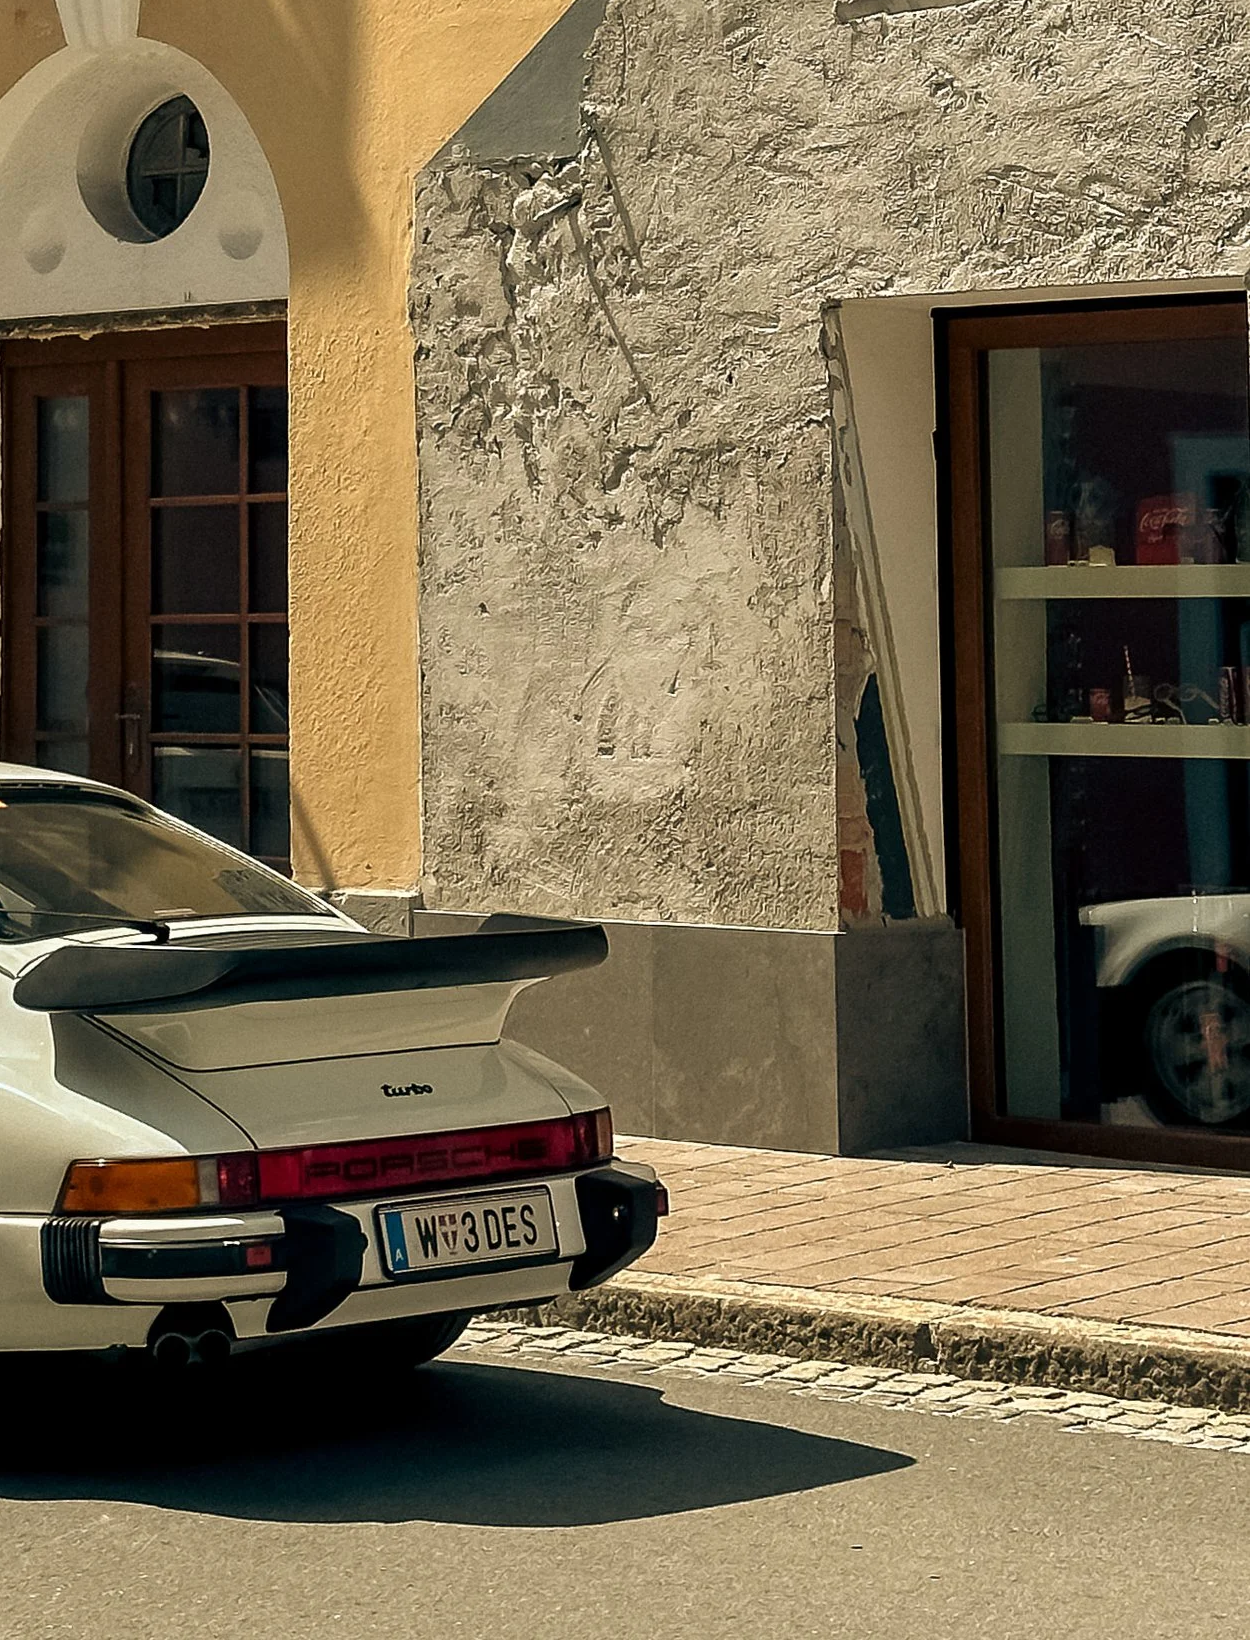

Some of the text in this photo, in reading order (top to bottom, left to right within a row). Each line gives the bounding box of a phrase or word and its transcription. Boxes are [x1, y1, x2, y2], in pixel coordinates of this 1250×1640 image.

[380, 1083, 434, 1098] turbo
[304, 1137, 550, 1184] PORSCHE
[395, 1248, 405, 1263] A
